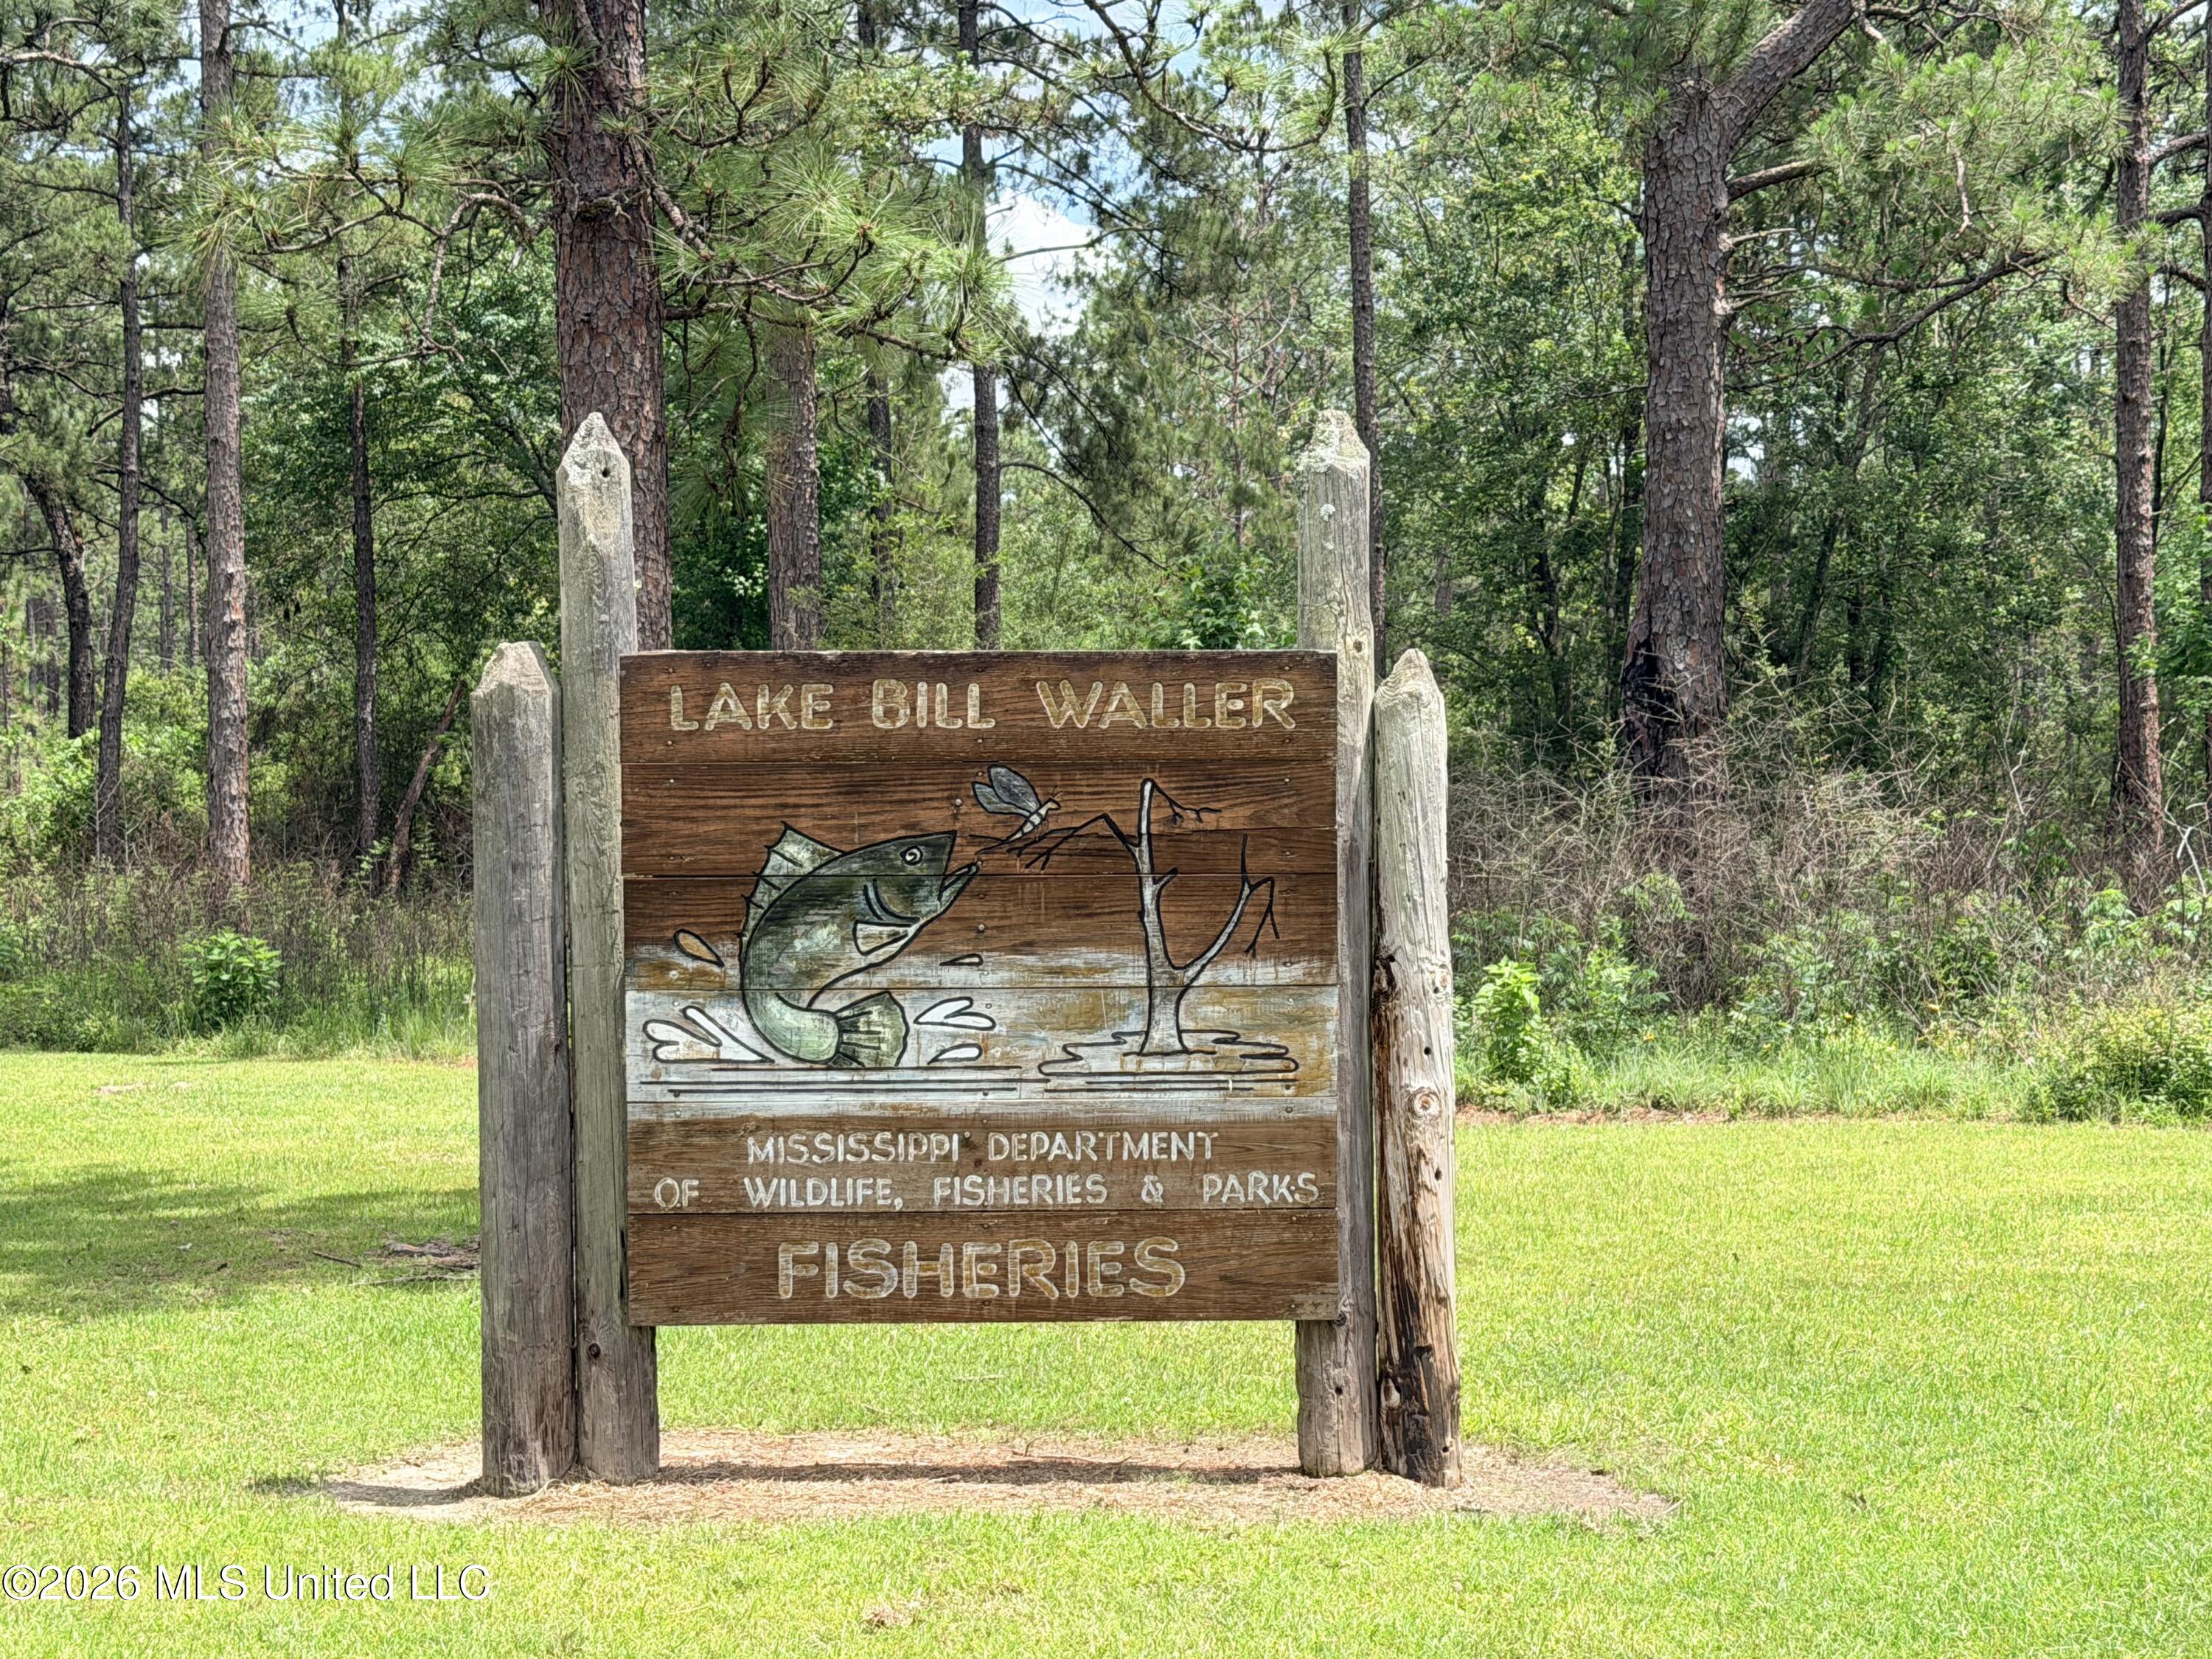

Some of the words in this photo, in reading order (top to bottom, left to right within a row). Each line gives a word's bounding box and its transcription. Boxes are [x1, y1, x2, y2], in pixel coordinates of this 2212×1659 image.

[670, 682, 834, 731] LAKE
[872, 678, 996, 731] BILL
[1035, 677, 1296, 731] WALLER
[746, 1132, 959, 1165] MISSISSIPPI
[989, 1130, 1219, 1163] DEPARTMENT
[654, 1177, 700, 1210] OF
[744, 1175, 904, 1211] WILDLIFE,
[933, 1172, 1108, 1207] FISHERIES
[1141, 1174, 1164, 1203] &
[1203, 1172, 1319, 1205] PARKS
[778, 1236, 1186, 1300] FISHERIES
